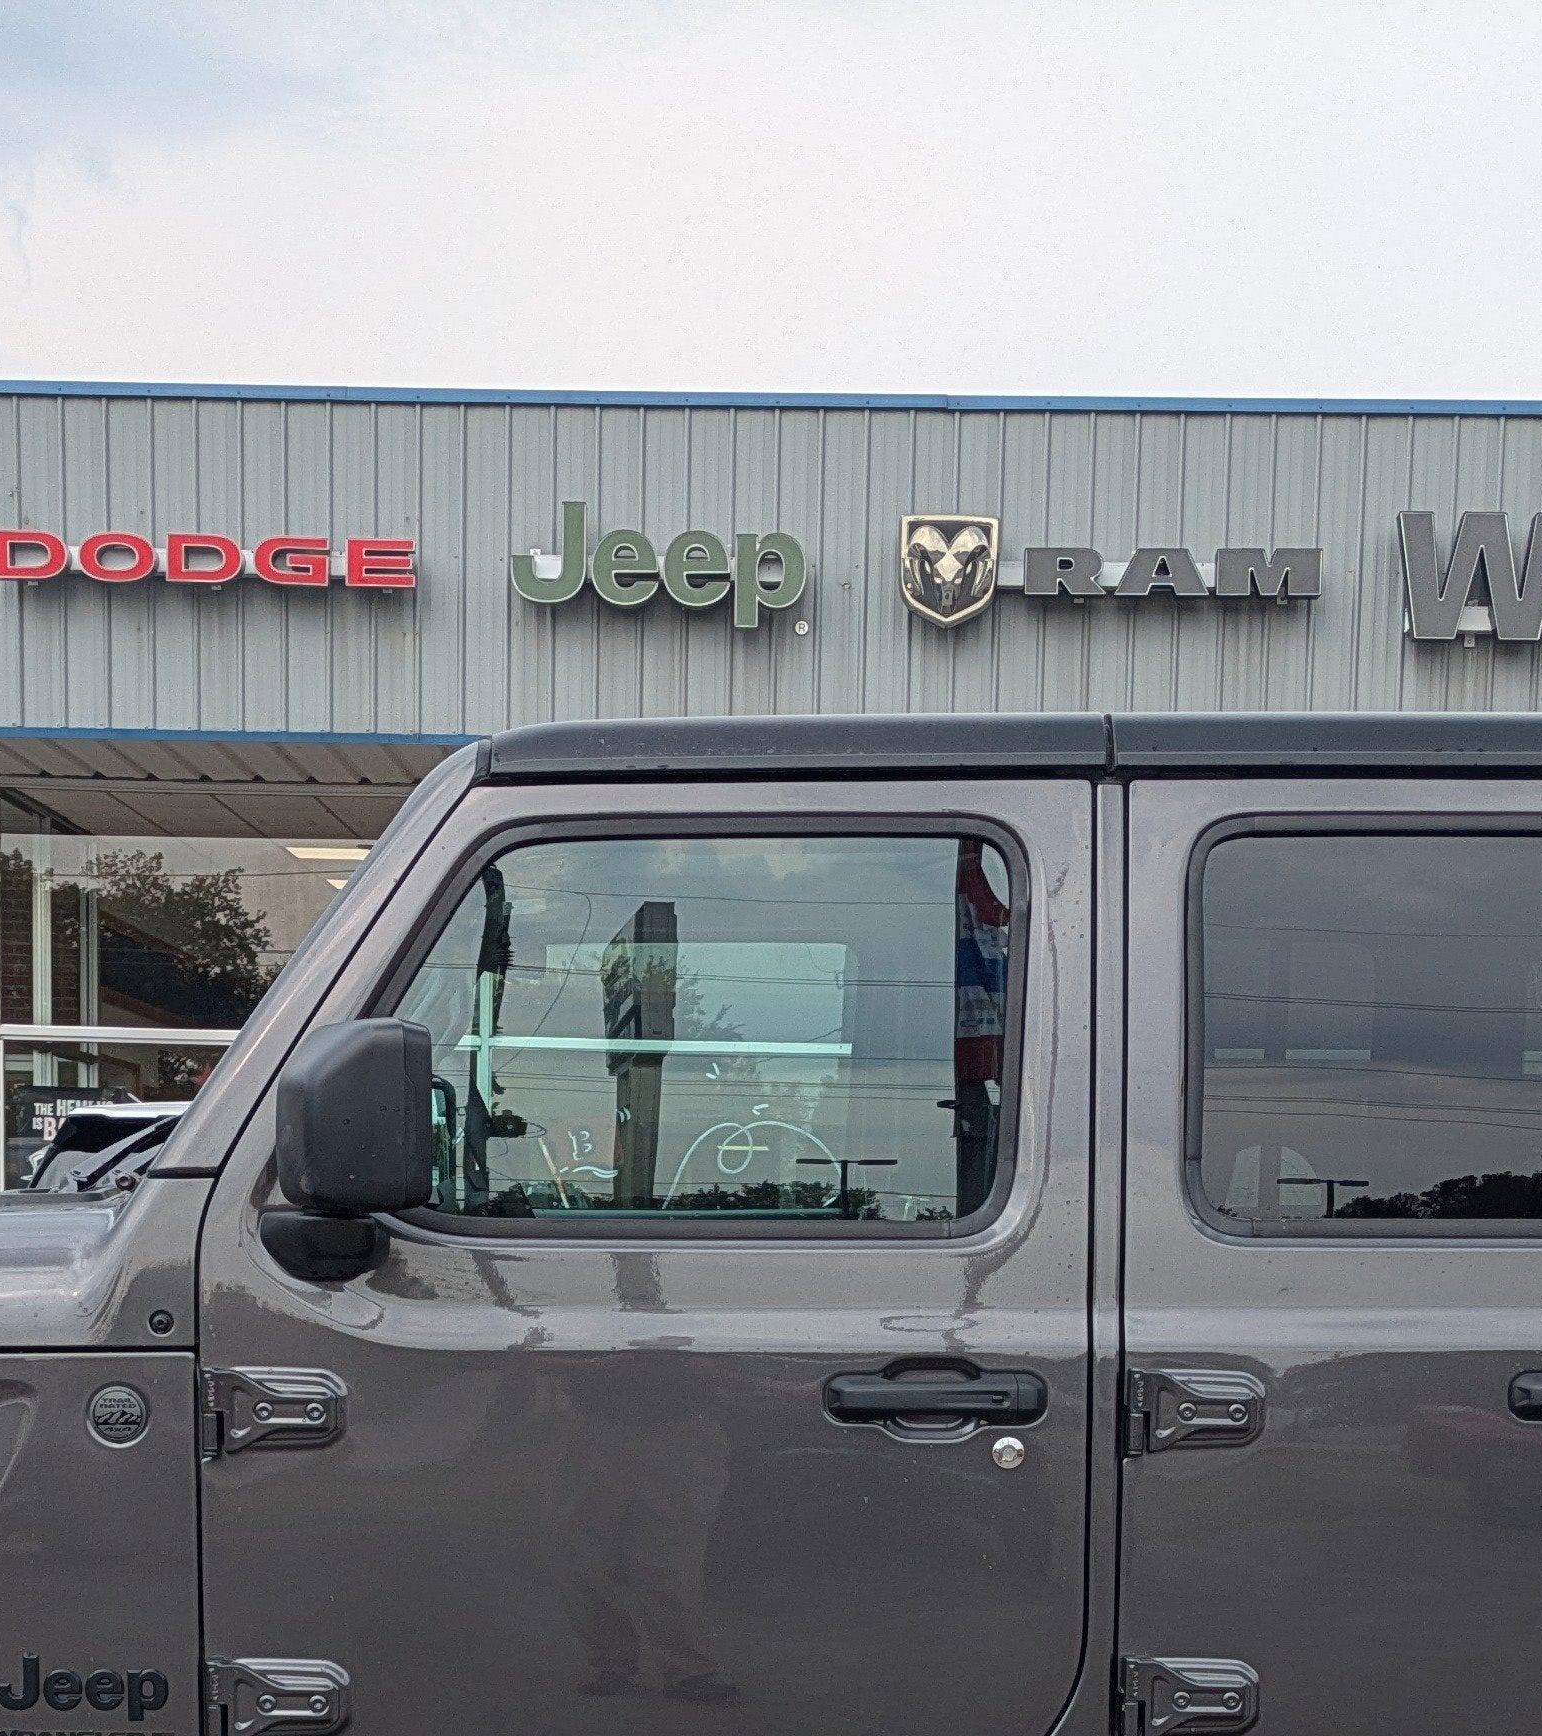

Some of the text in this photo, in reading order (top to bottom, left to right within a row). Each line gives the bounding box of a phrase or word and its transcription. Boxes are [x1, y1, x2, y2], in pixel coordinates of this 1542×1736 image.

[511, 501, 807, 628] Jeep
[1023, 547, 1323, 598] RAM
[33, 1102, 54, 1116] THE
